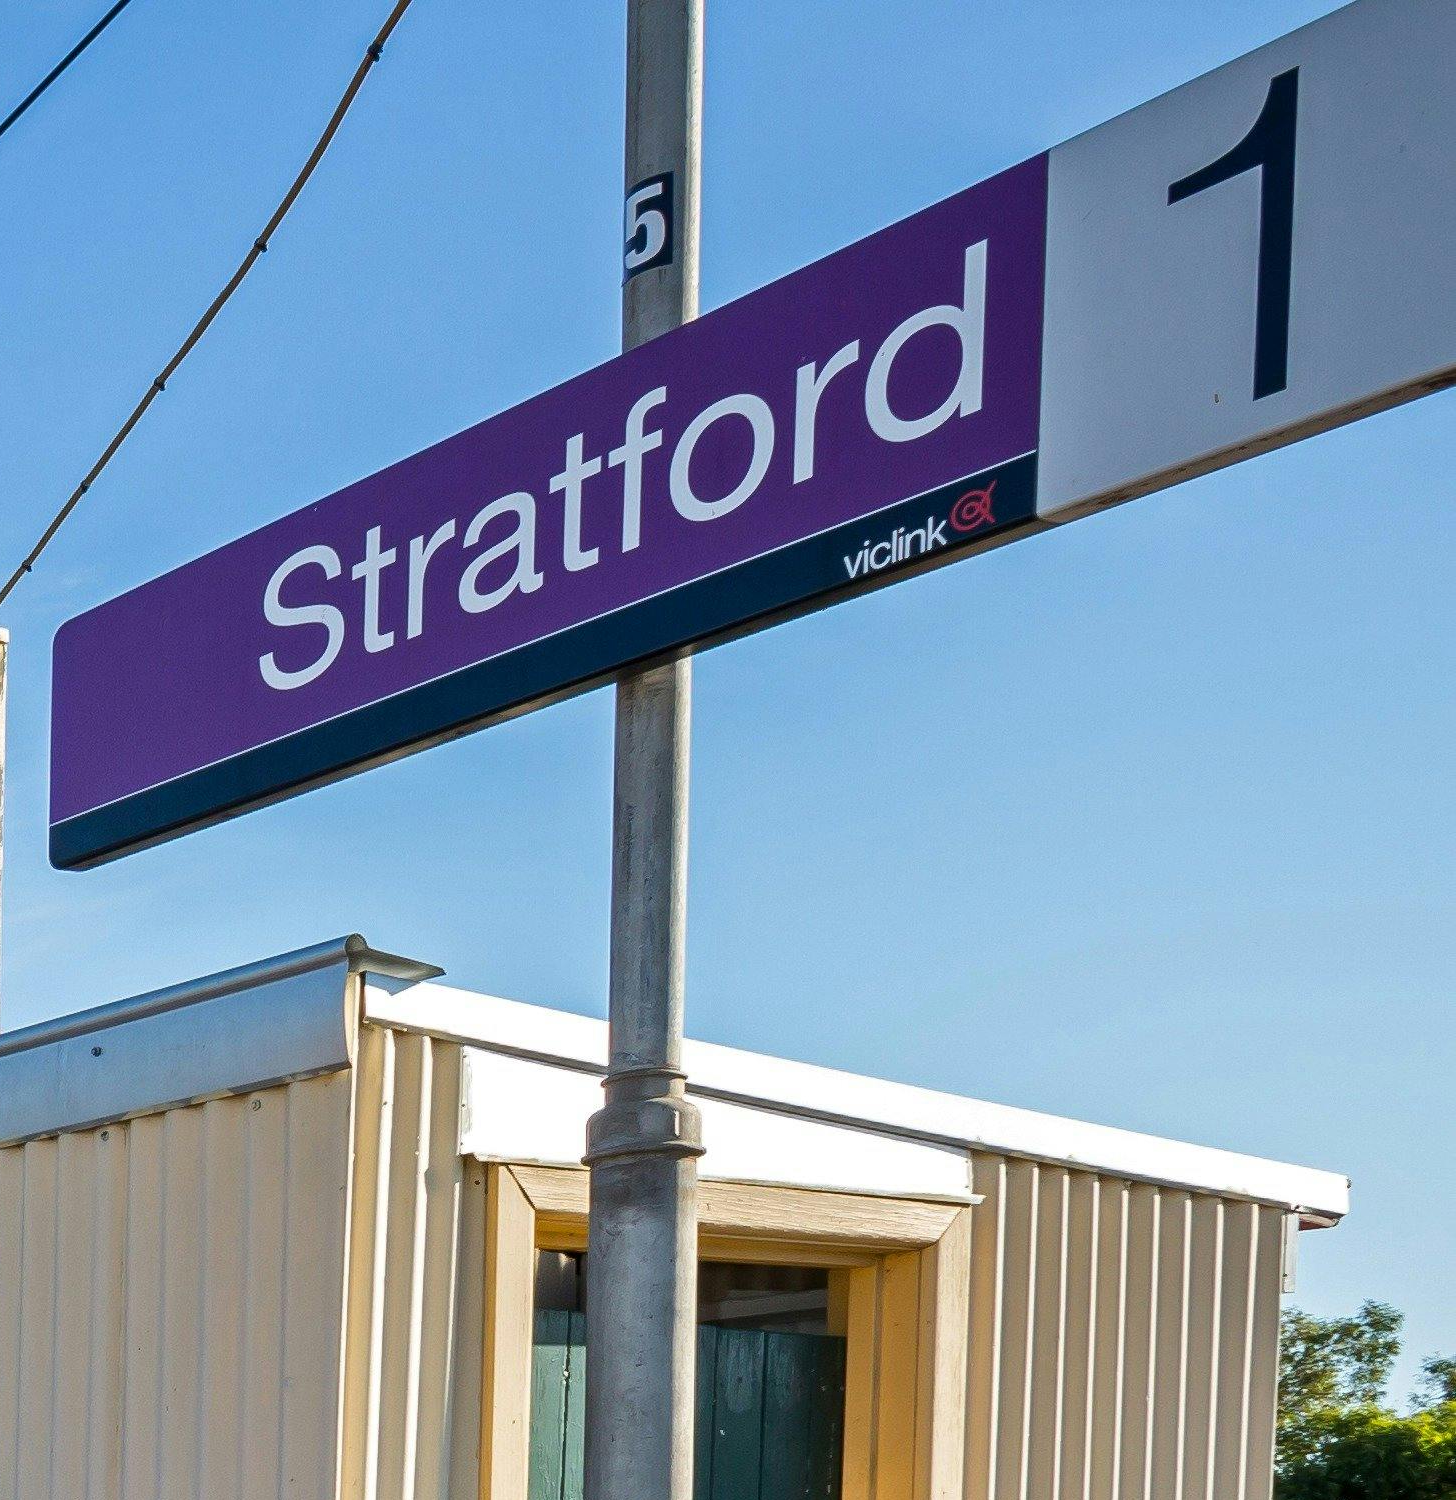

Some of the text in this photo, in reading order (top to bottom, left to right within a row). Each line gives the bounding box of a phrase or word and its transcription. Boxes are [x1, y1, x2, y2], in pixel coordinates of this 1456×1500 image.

[624, 181, 666, 270] 5
[1167, 65, 1300, 402] 1
[258, 238, 988, 692] Stratford
[843, 514, 948, 580] viclink
